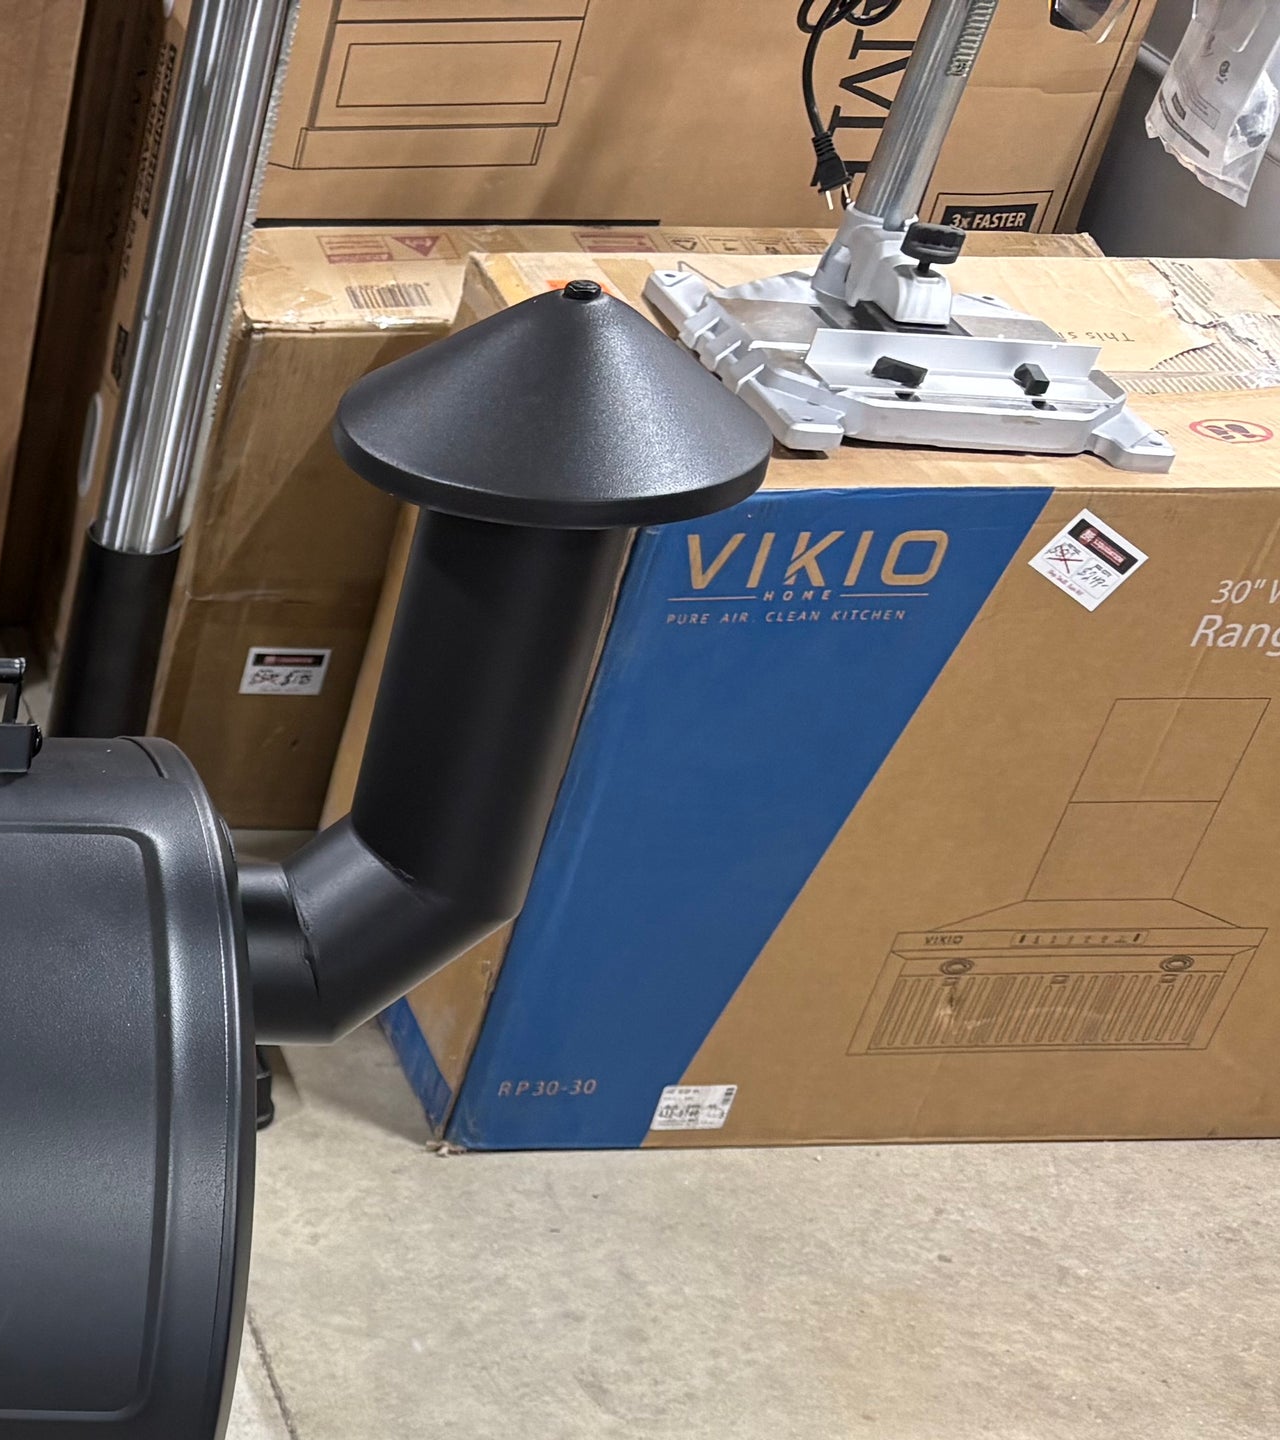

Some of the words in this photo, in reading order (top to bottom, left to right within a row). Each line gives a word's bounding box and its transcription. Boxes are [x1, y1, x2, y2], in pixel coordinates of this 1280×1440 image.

[949, 213, 971, 229] 3x
[972, 212, 1028, 229] FASTER
[1086, 332, 1136, 343] This
[687, 529, 949, 590] VIKIO
[763, 590, 833, 602] HOME
[1211, 579, 1267, 604] 30"
[666, 613, 710, 625] PURE
[765, 610, 821, 623] CLEAN
[830, 609, 907, 621] KITCHEN
[924, 935, 964, 946] VIKIO
